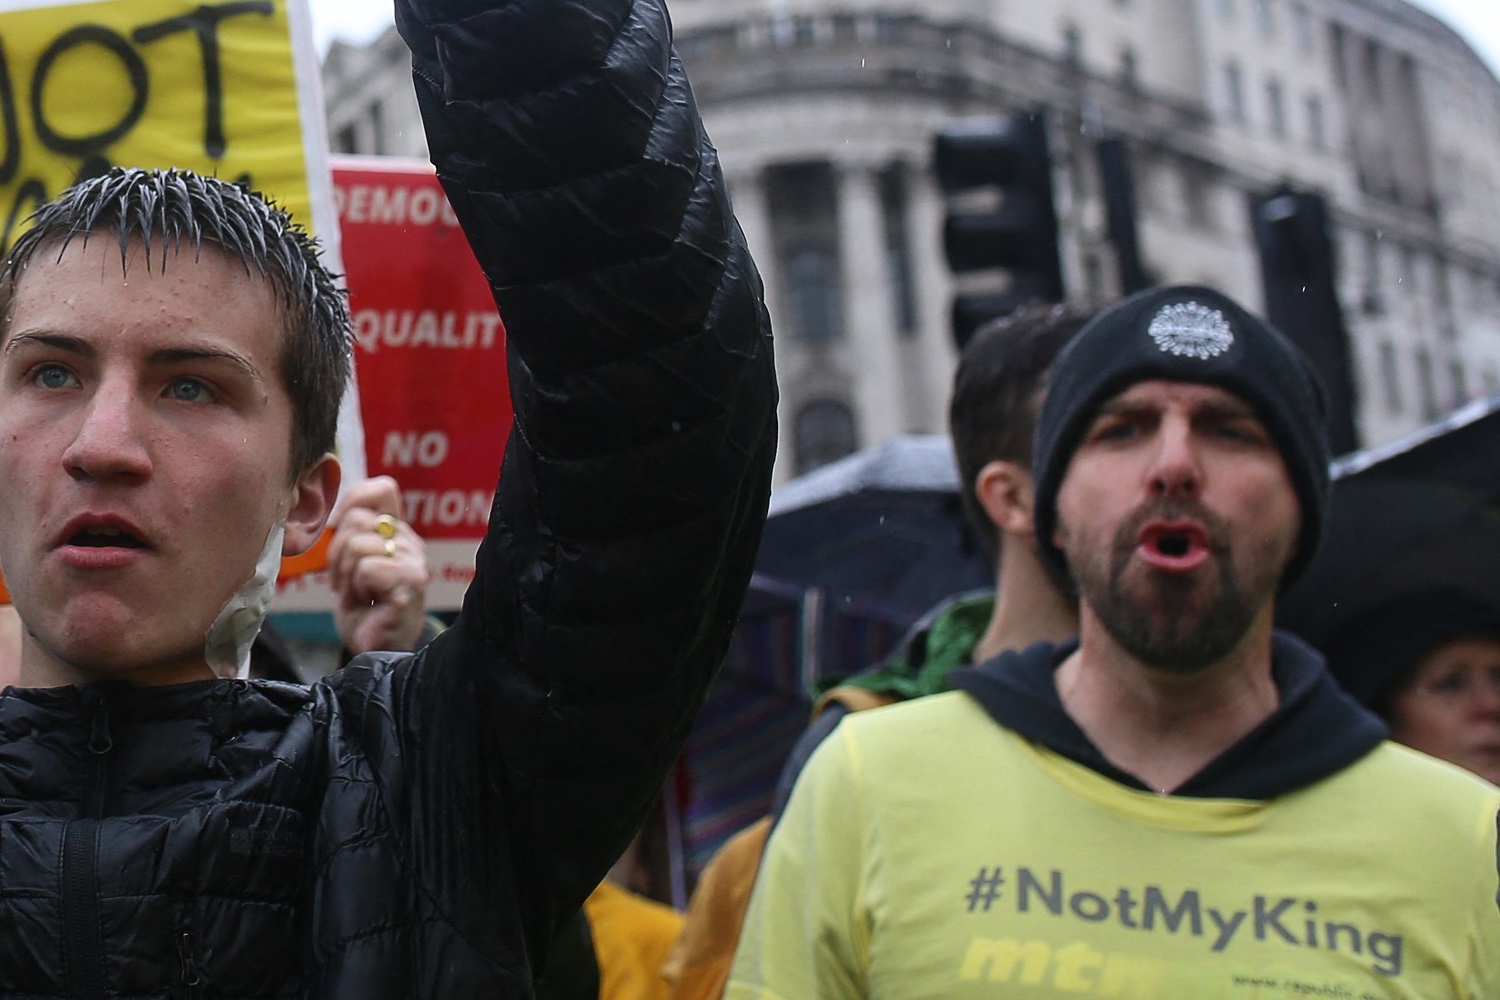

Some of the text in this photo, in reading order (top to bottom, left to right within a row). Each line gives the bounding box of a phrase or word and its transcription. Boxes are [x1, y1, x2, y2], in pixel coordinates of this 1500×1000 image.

[356, 309, 501, 353] QUALIT
[382, 432, 448, 467] NO
[965, 867, 1405, 977] #NotMyKing
